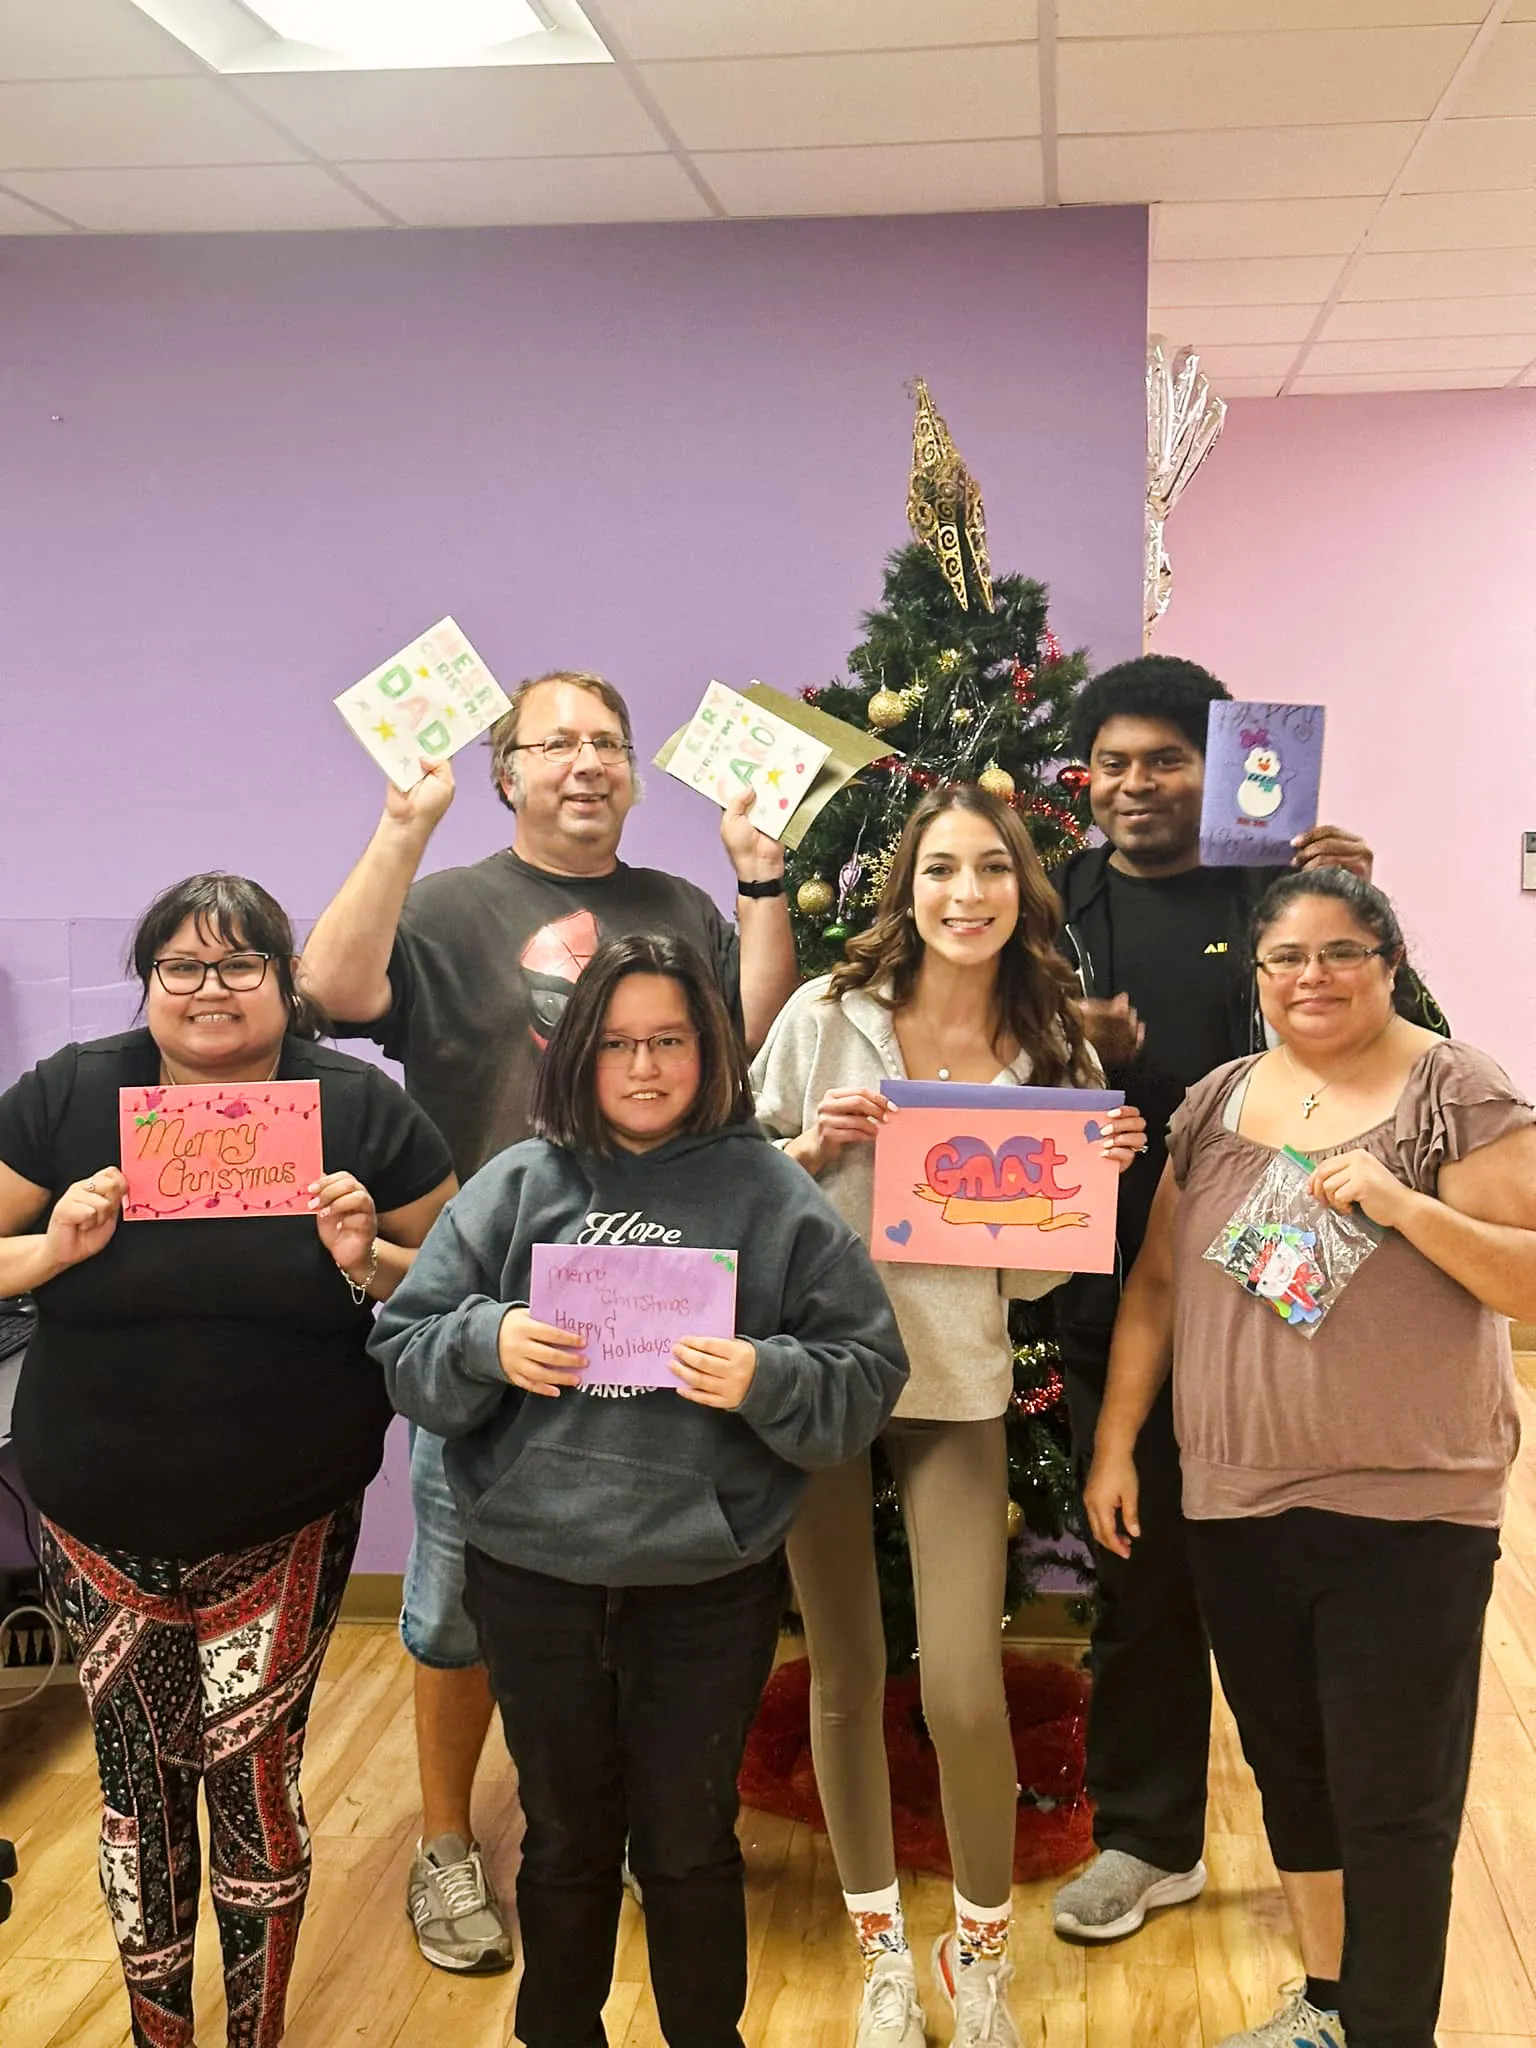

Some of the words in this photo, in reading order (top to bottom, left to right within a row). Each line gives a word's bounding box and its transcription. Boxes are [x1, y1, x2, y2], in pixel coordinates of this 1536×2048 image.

[376, 663, 453, 756] DAD
[136, 1118, 267, 1164] Merry
[577, 1211, 682, 1245] Hope
[555, 1309, 602, 1342] Happy
[602, 1337, 672, 1361] Holidays
